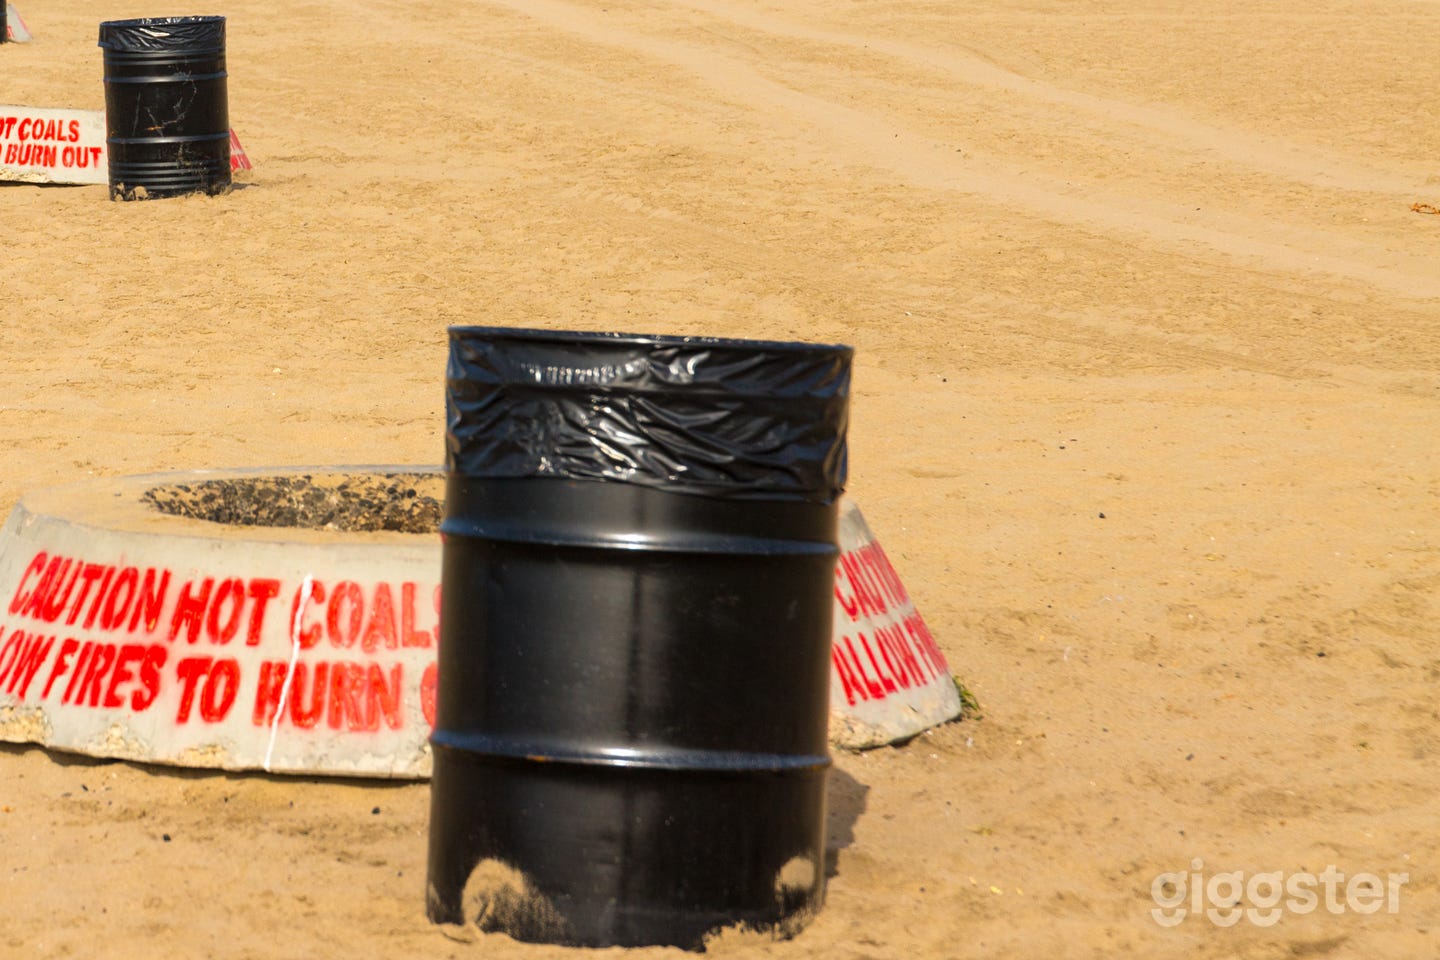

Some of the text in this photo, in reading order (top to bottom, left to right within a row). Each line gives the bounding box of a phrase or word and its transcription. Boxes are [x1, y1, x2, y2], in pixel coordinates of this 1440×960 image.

[4, 143, 57, 168] BURN
[61, 147, 103, 170] OUT
[18, 117, 80, 143] COALS
[8, 551, 172, 634] CAUTION
[167, 576, 281, 647] HOT
[39, 637, 168, 712] FIRES
[176, 655, 241, 725] TO
[251, 660, 403, 733] BURN
